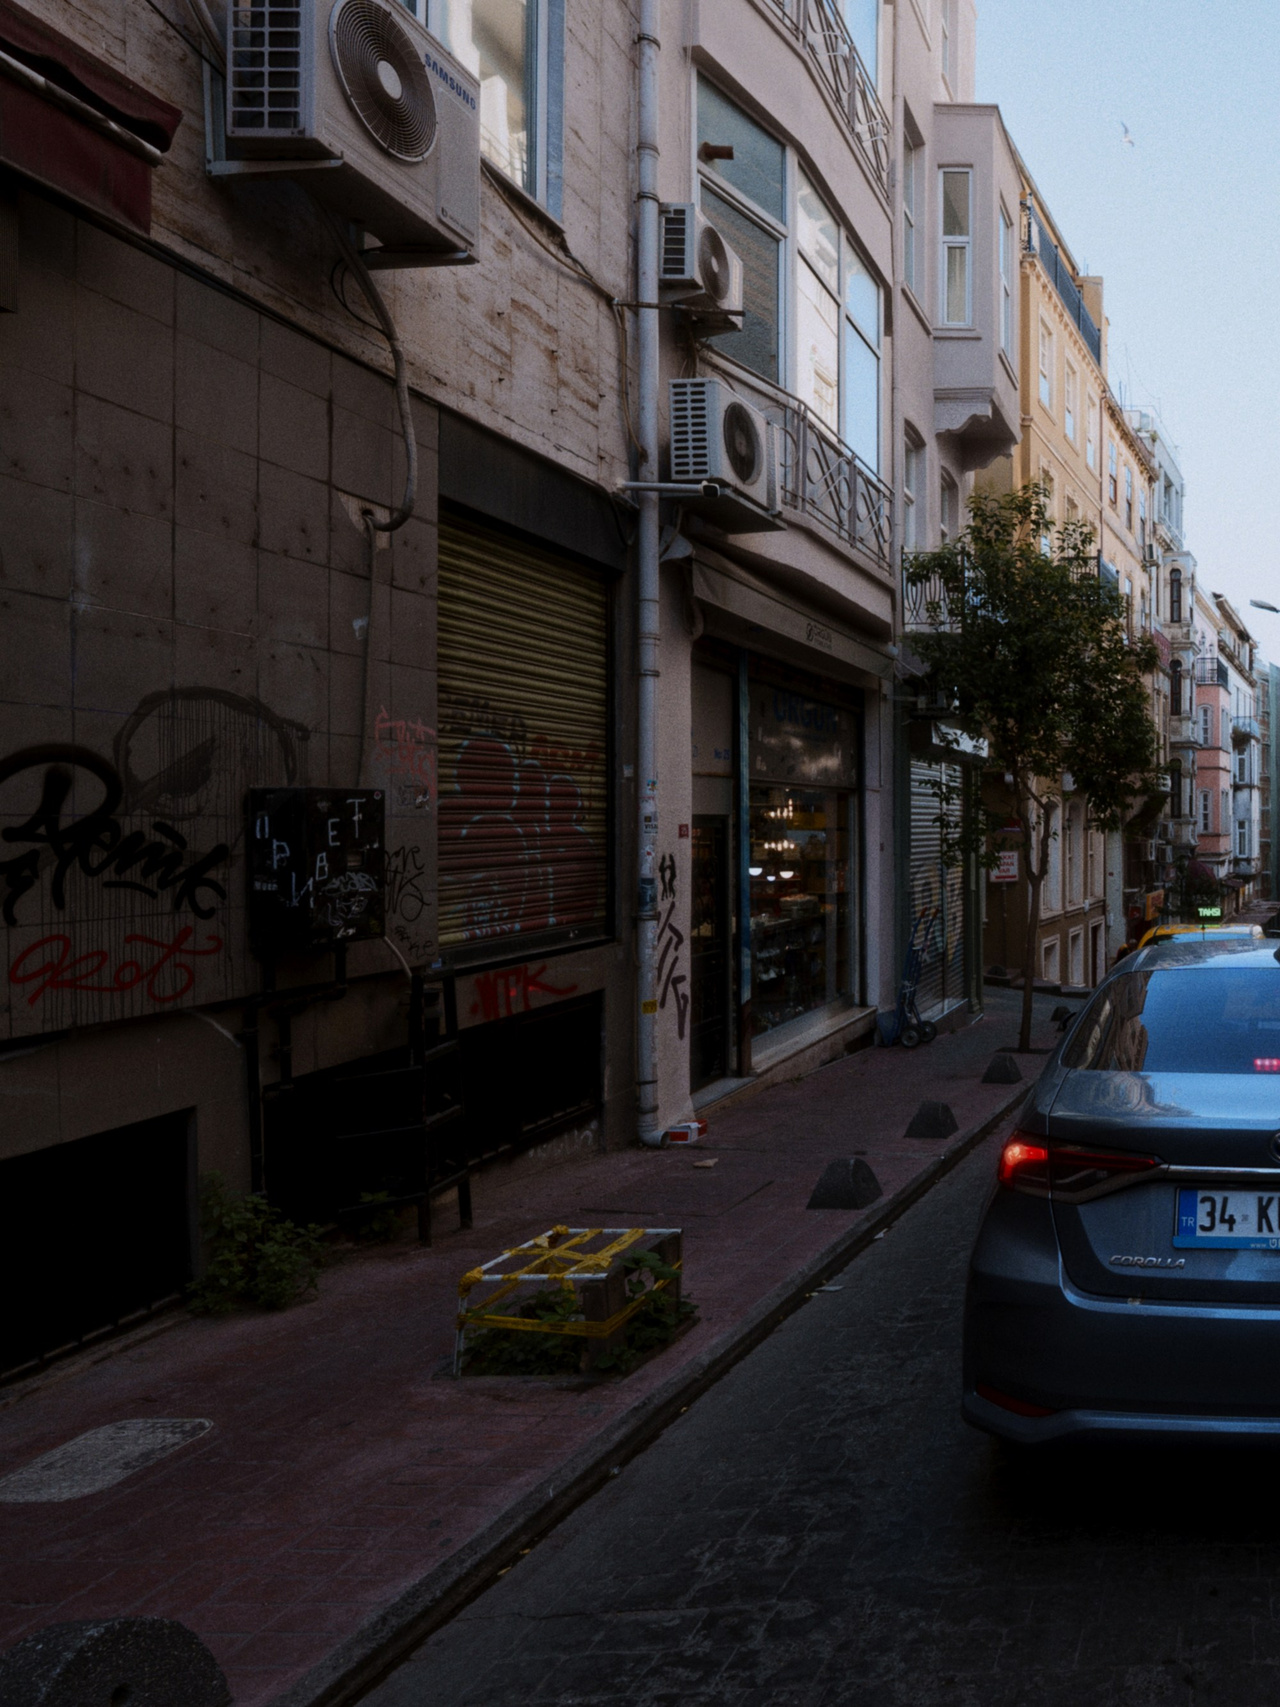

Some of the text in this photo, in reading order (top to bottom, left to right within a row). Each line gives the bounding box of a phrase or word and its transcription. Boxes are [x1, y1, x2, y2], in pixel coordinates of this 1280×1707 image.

[425, 53, 476, 110] SAMSUNG
[1181, 1215, 1195, 1228] TR
[1199, 1195, 1236, 1233] 34
[1109, 1255, 1186, 1270] COROLLA
